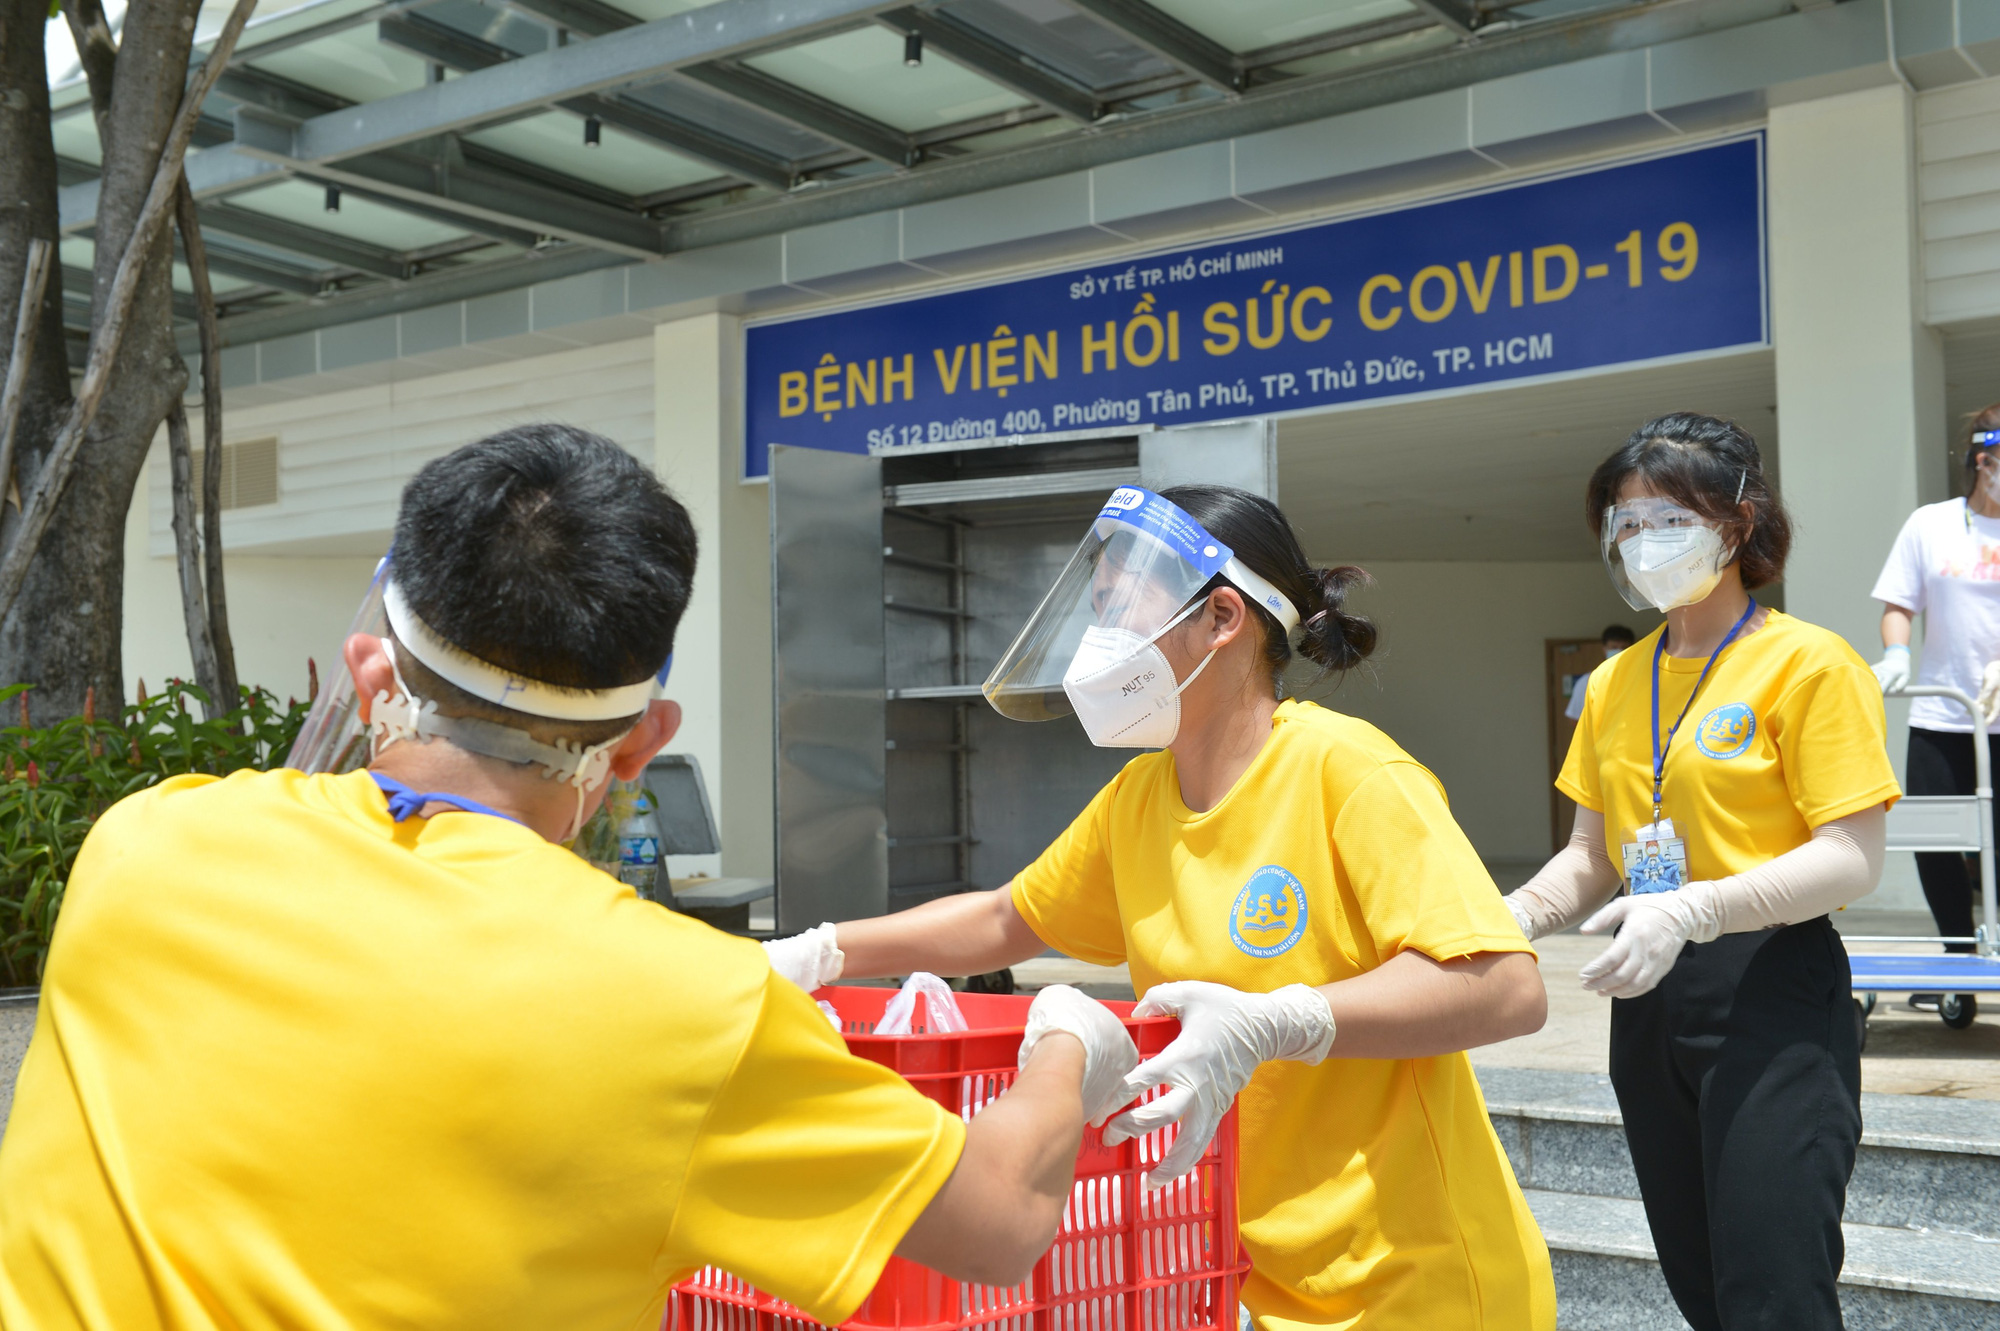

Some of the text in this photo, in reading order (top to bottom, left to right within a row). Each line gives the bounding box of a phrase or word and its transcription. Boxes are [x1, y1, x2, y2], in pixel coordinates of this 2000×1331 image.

[1070, 246, 1283, 300] SỞ Y TẾ TP. HỒ CHÍ MINH
[778, 221, 1700, 423] BỆNH VIỆN HỒI SỨC COVID-19
[866, 332, 1554, 449] Số 12 Đường 400, Phường Tân Phú, TP. Thủ Đức, TP. HCM
[1170, 528, 1186, 543] before
[1179, 528, 1197, 544] plastic
[1184, 524, 1201, 540] please
[1121, 674, 1142, 697] NUT
[1142, 670, 1156, 683] 95
[1262, 947, 1279, 957] NAM
